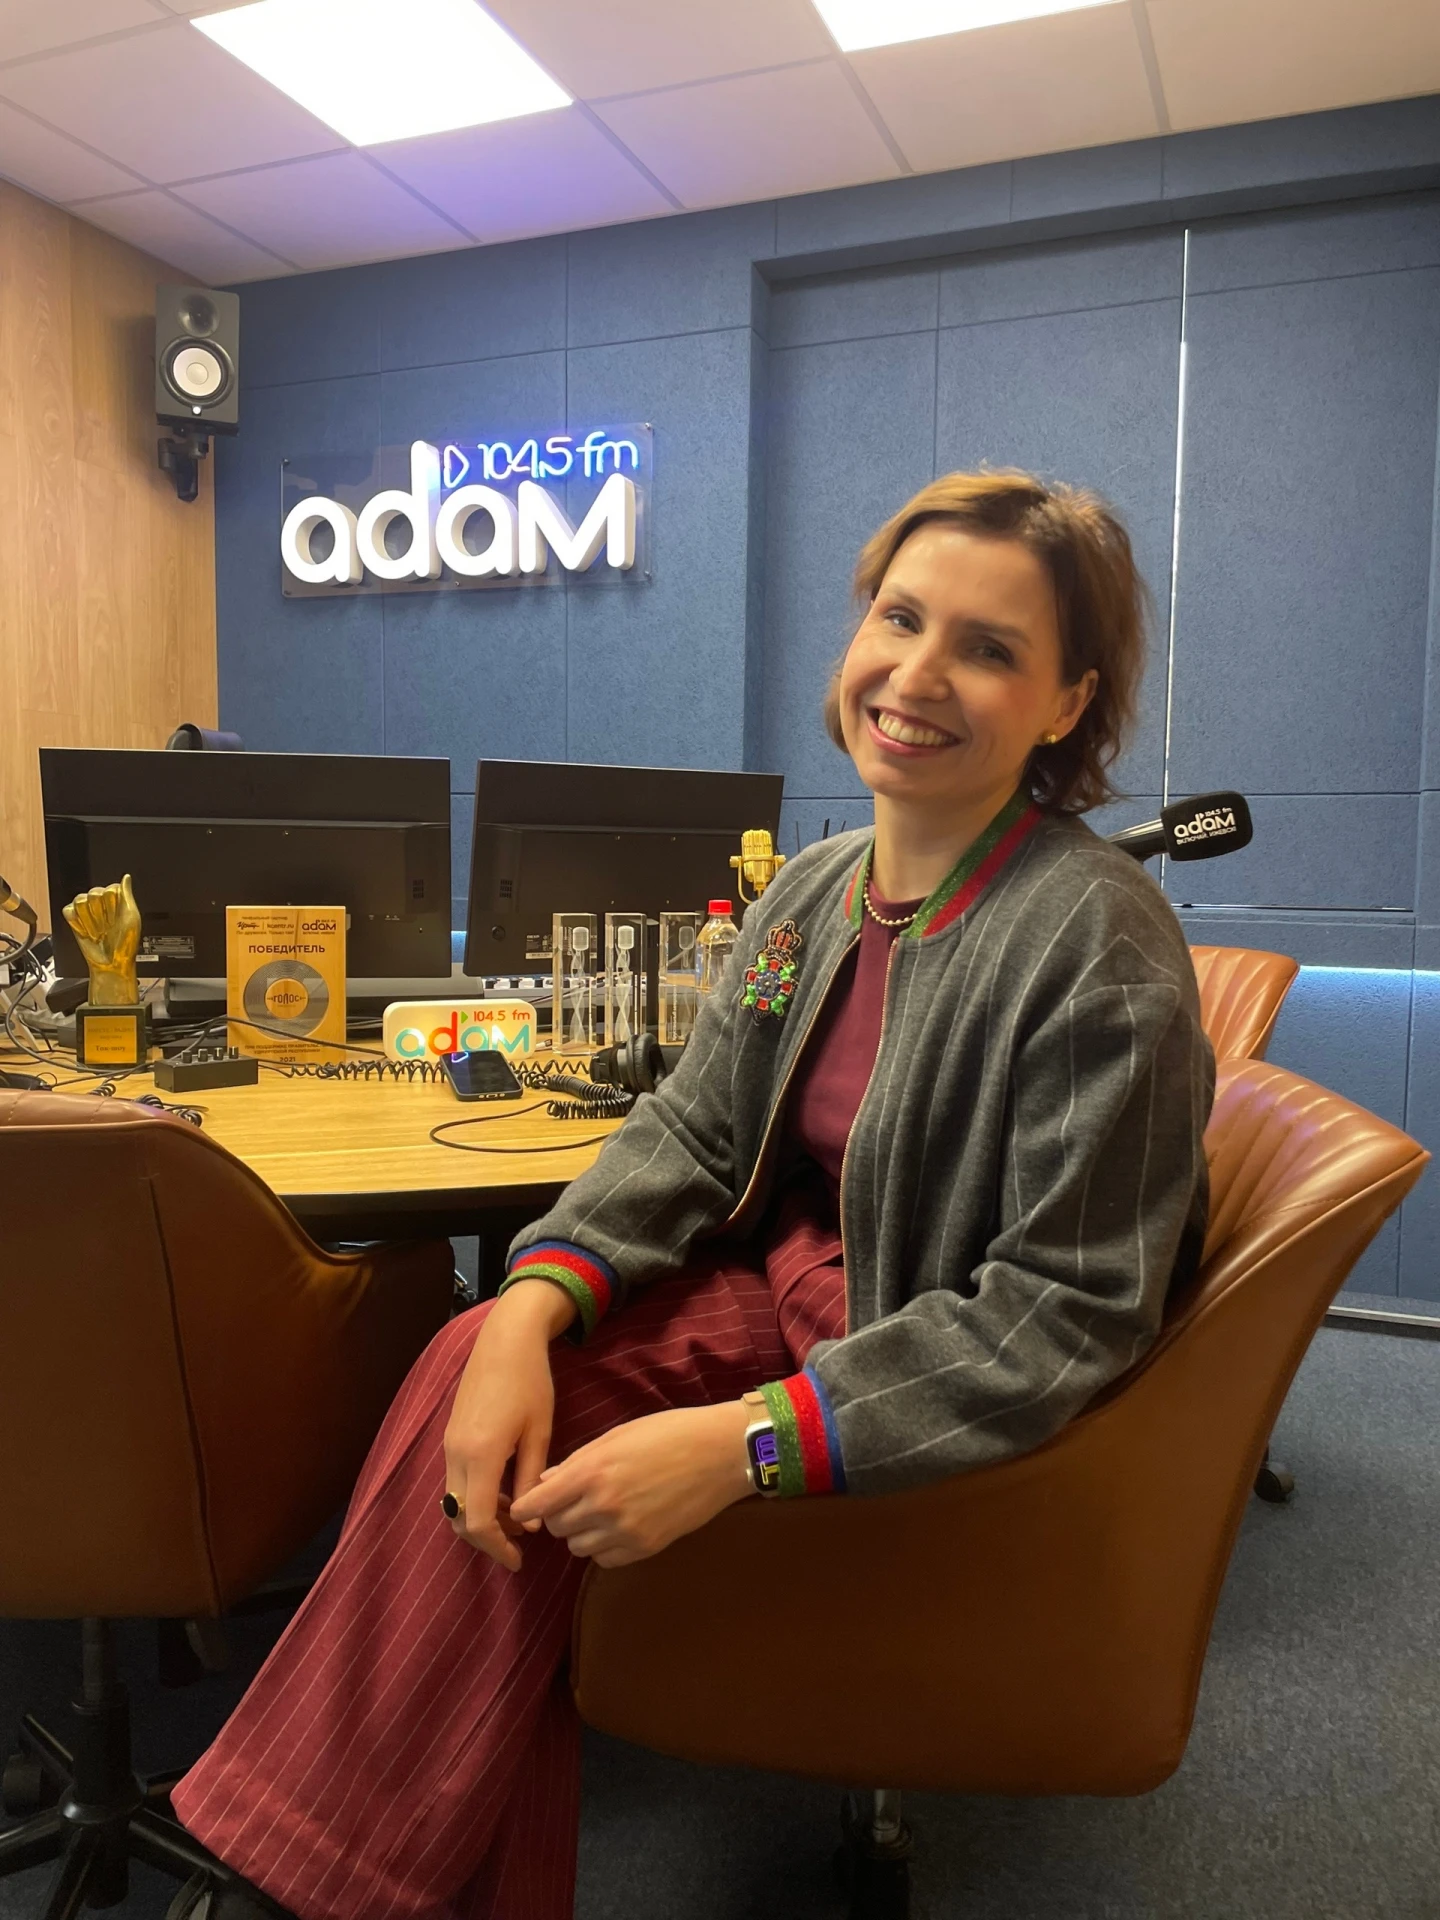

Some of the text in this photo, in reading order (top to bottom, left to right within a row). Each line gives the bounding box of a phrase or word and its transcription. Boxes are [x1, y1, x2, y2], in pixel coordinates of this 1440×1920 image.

[576, 431, 638, 478] fm
[248, 945, 325, 954] ПОБЕДИТЕЛЬ
[473, 1009, 530, 1022] 104.5 fm
